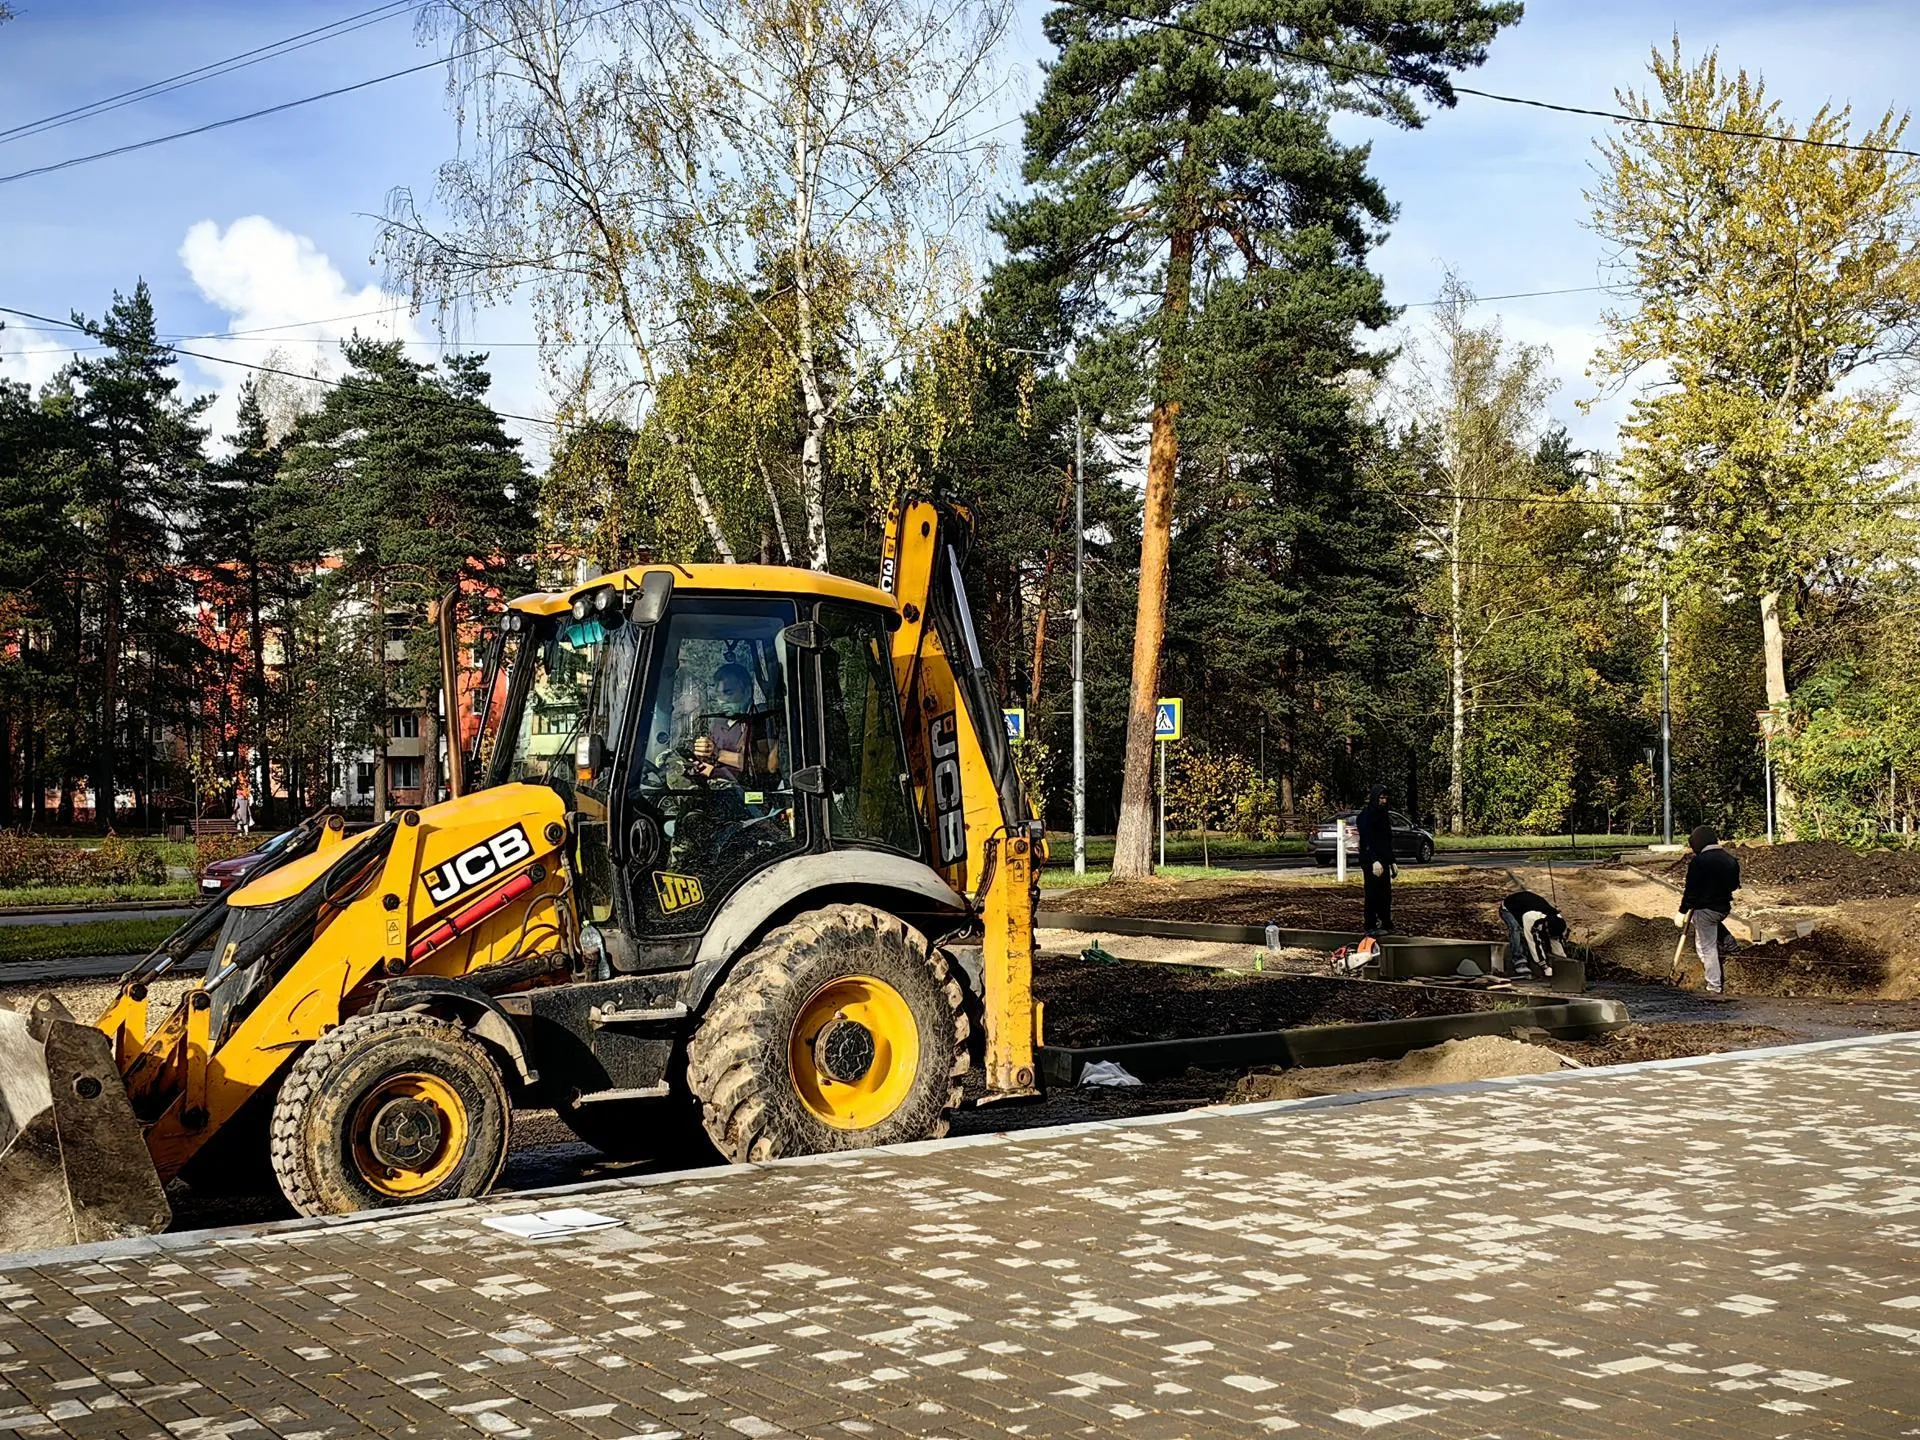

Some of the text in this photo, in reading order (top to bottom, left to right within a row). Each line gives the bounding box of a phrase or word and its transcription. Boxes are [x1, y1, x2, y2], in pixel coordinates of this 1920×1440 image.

[931, 719, 965, 863] JCB
[431, 828, 530, 902] JCB
[661, 875, 702, 910] JCB
